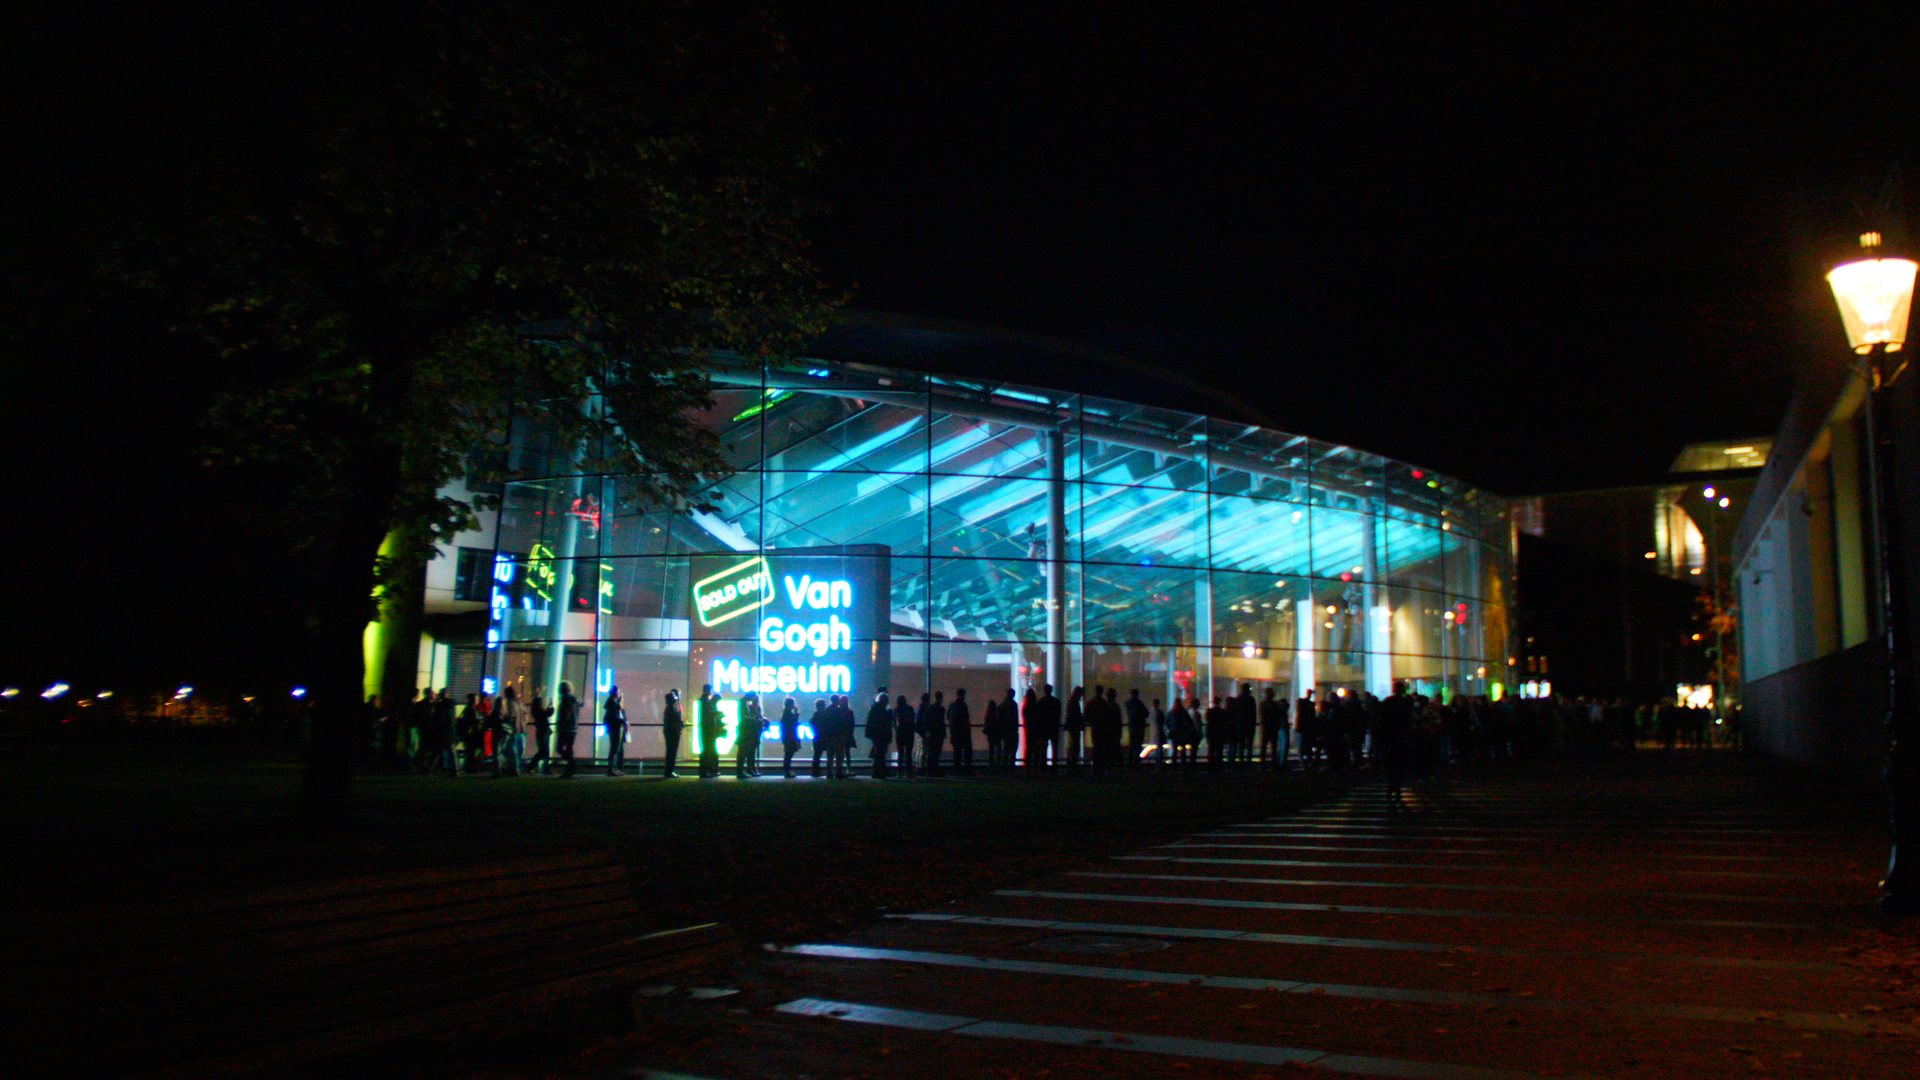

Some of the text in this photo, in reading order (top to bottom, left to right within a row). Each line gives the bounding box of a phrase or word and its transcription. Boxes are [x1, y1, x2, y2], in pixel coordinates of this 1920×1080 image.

[701, 585, 737, 611] SOLD
[784, 574, 851, 610] Van
[759, 614, 851, 657] Gogh
[712, 658, 851, 693] Museum
